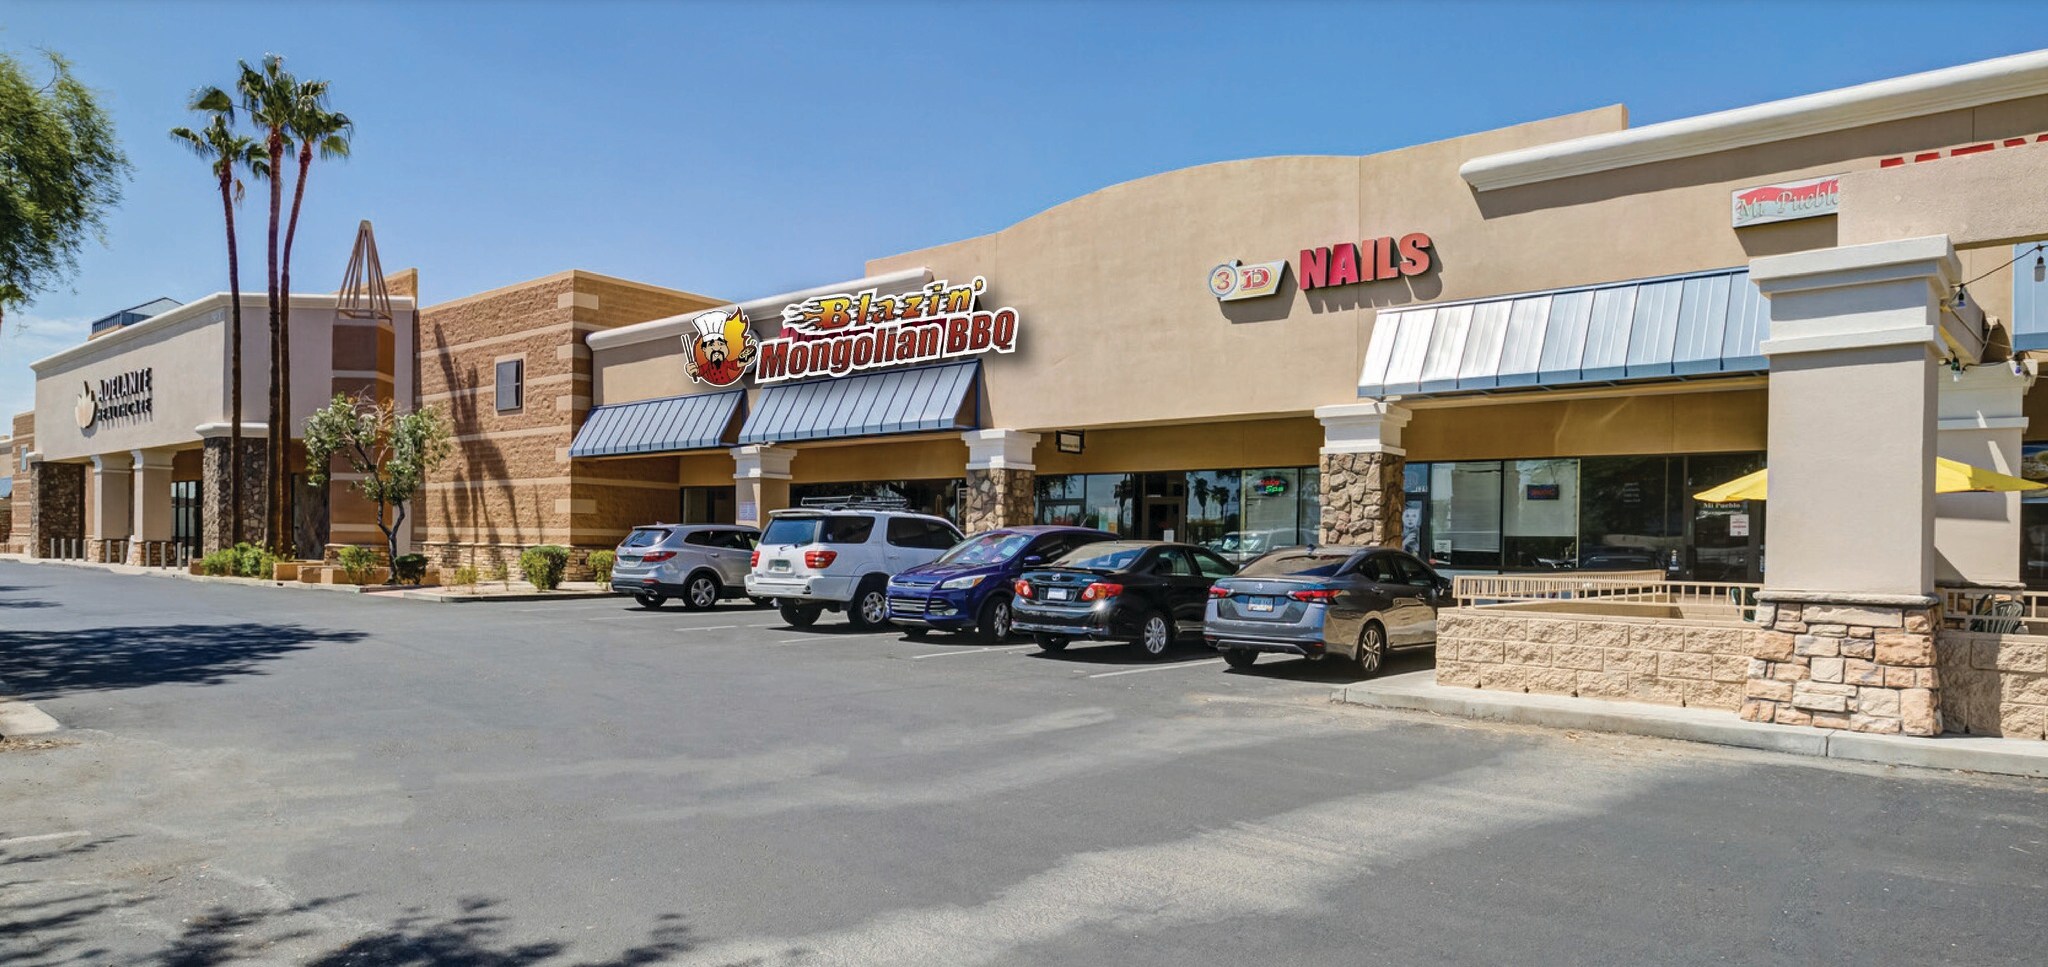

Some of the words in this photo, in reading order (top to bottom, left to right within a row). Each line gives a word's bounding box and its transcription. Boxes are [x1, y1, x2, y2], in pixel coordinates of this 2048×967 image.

[1300, 233, 1431, 290] NAILS
[805, 279, 984, 331] Blazin'
[757, 327, 940, 380] Mongolian
[946, 310, 1016, 354] BBQ
[97, 398, 152, 421] HEALTHCARE
[98, 367, 152, 401] ADELANTE
